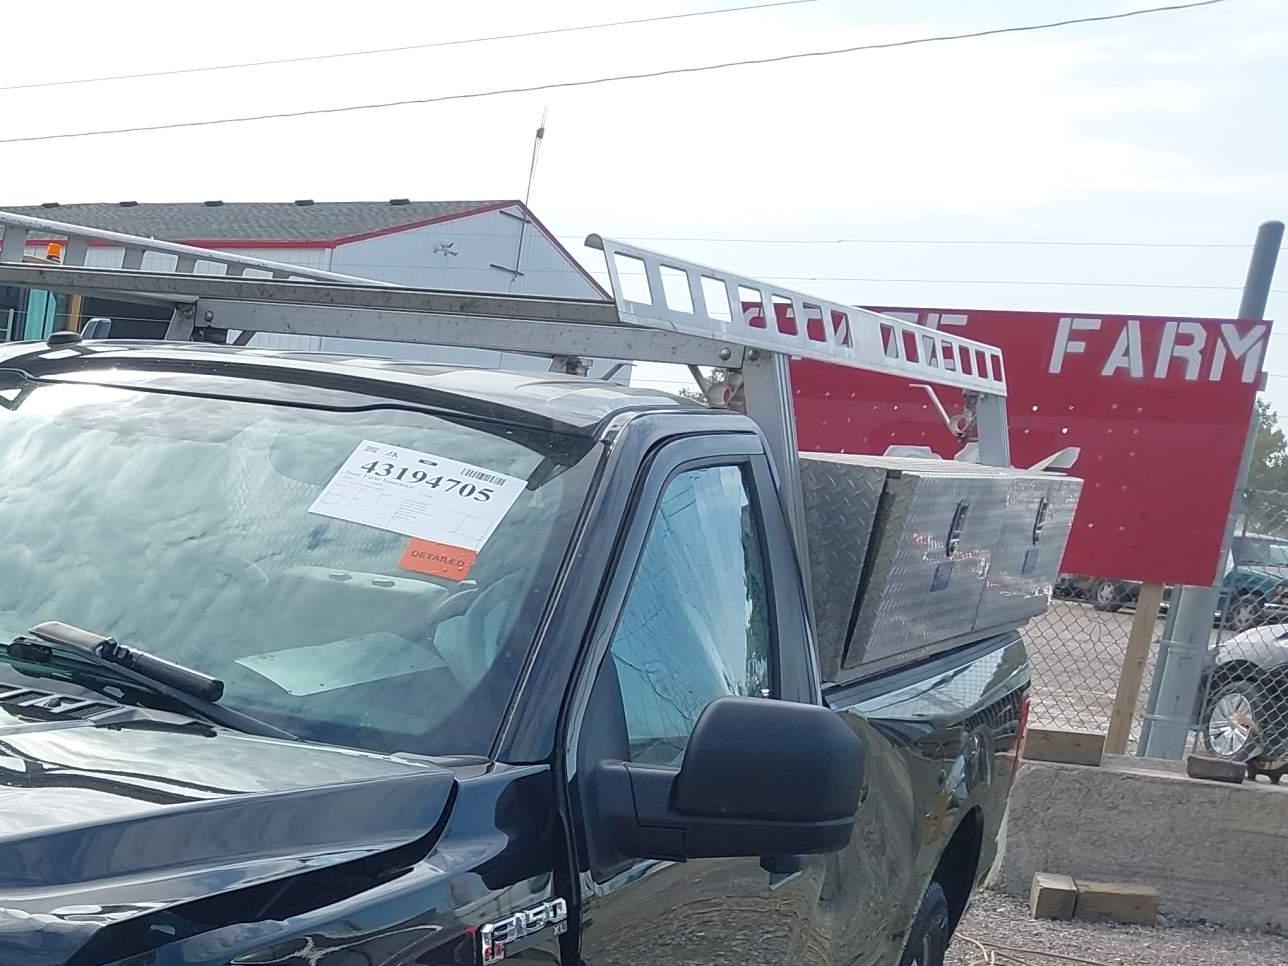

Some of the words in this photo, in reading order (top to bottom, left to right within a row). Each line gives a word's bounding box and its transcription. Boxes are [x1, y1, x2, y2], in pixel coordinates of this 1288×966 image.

[1048, 317, 1267, 383] FARM
[360, 460, 495, 502] 43194705
[410, 550, 466, 567] DETAILED
